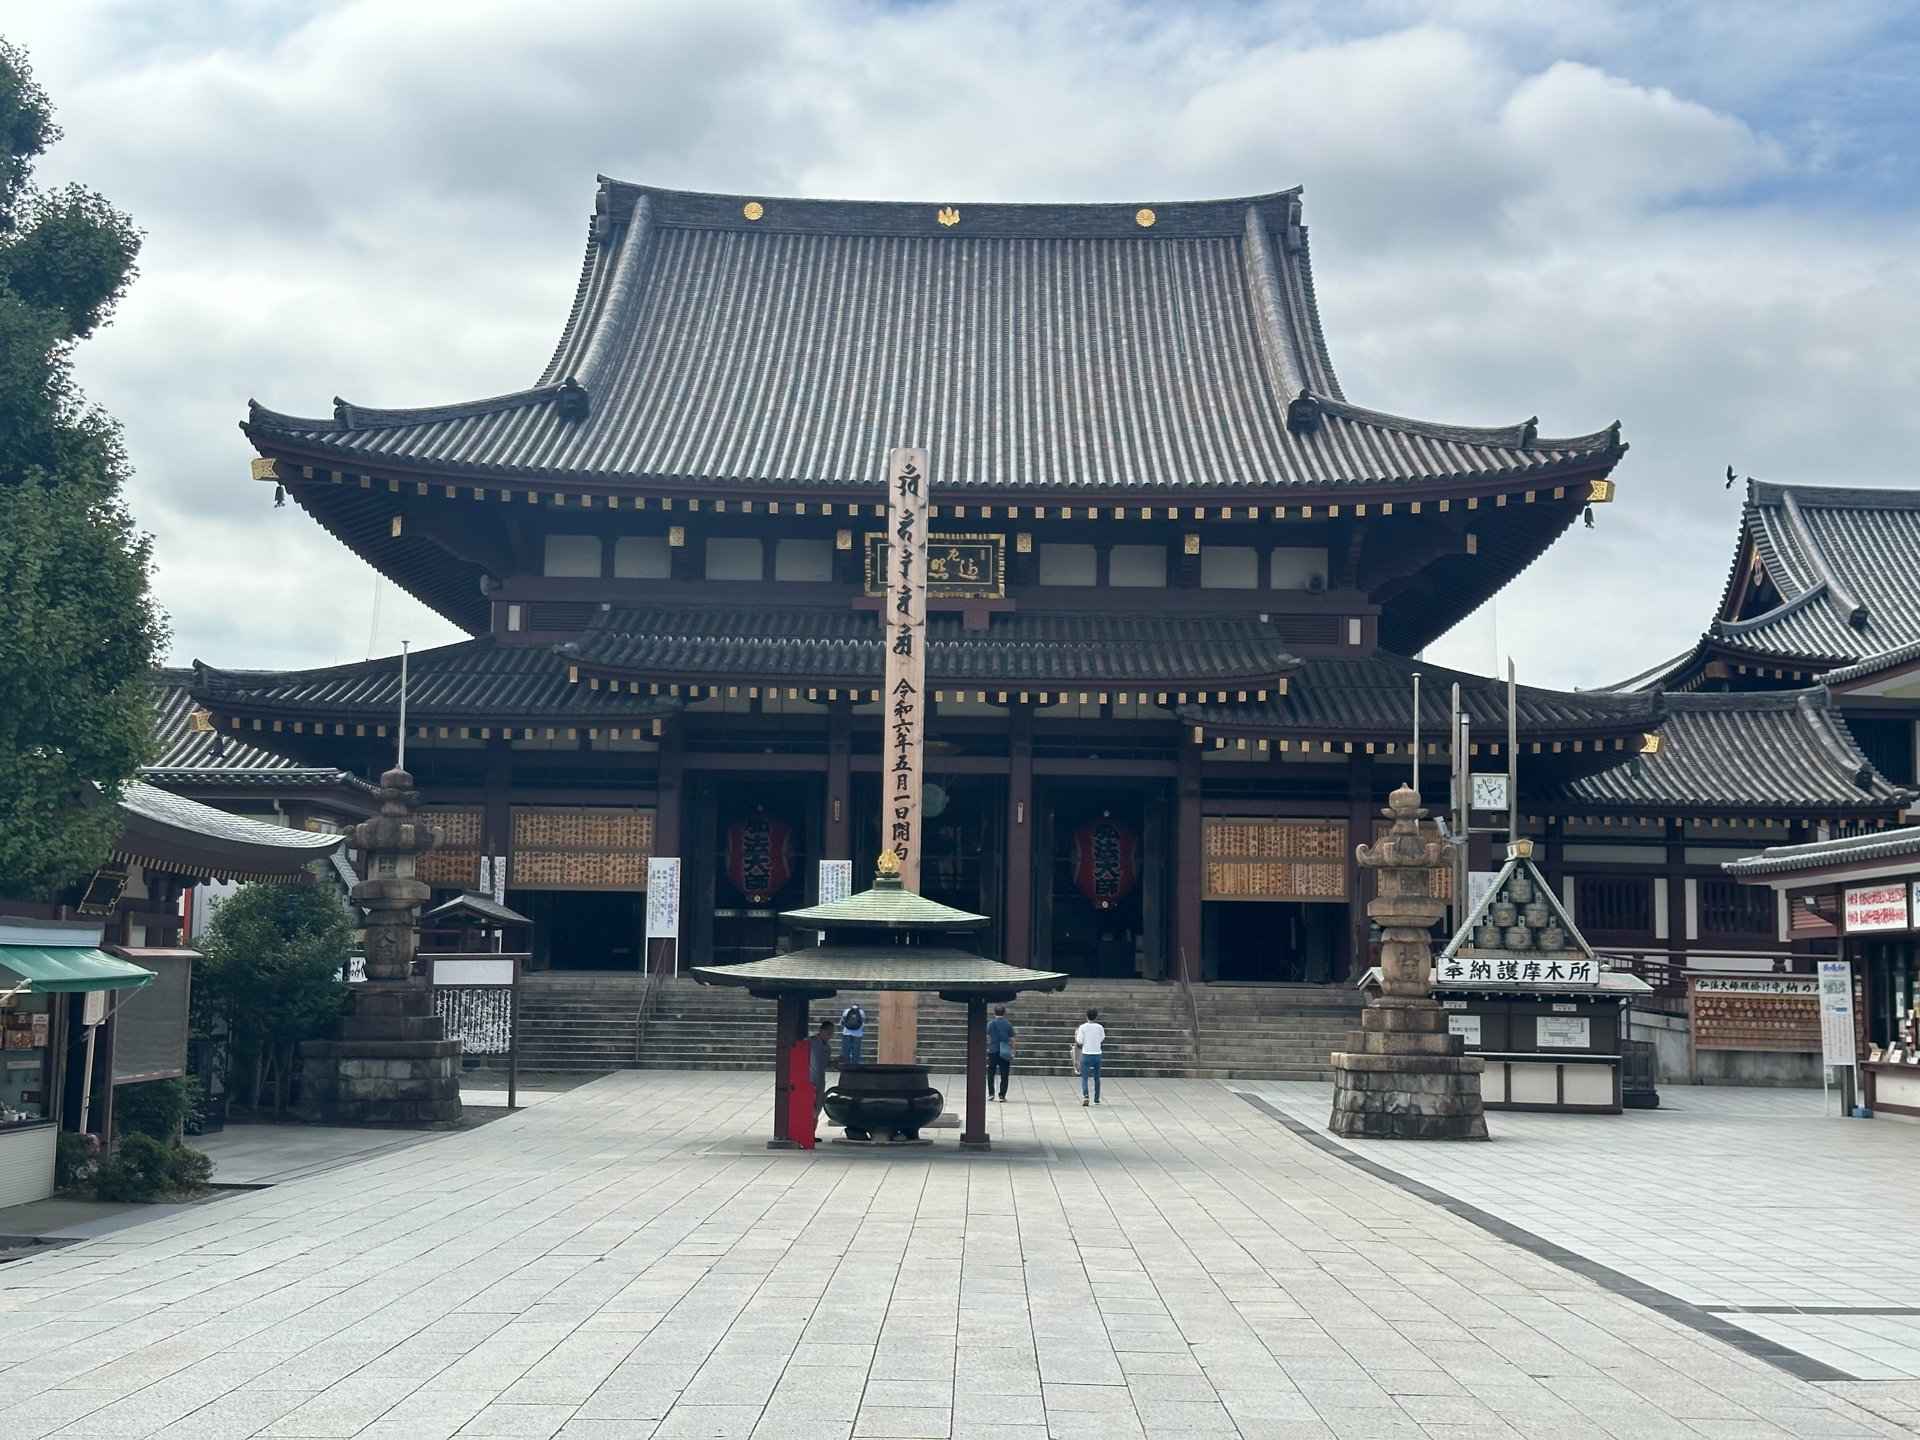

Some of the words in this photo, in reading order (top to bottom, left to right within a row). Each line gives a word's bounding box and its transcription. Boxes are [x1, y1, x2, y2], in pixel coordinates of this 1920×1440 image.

[1444, 959, 1591, 982] 奉納護摩木所
